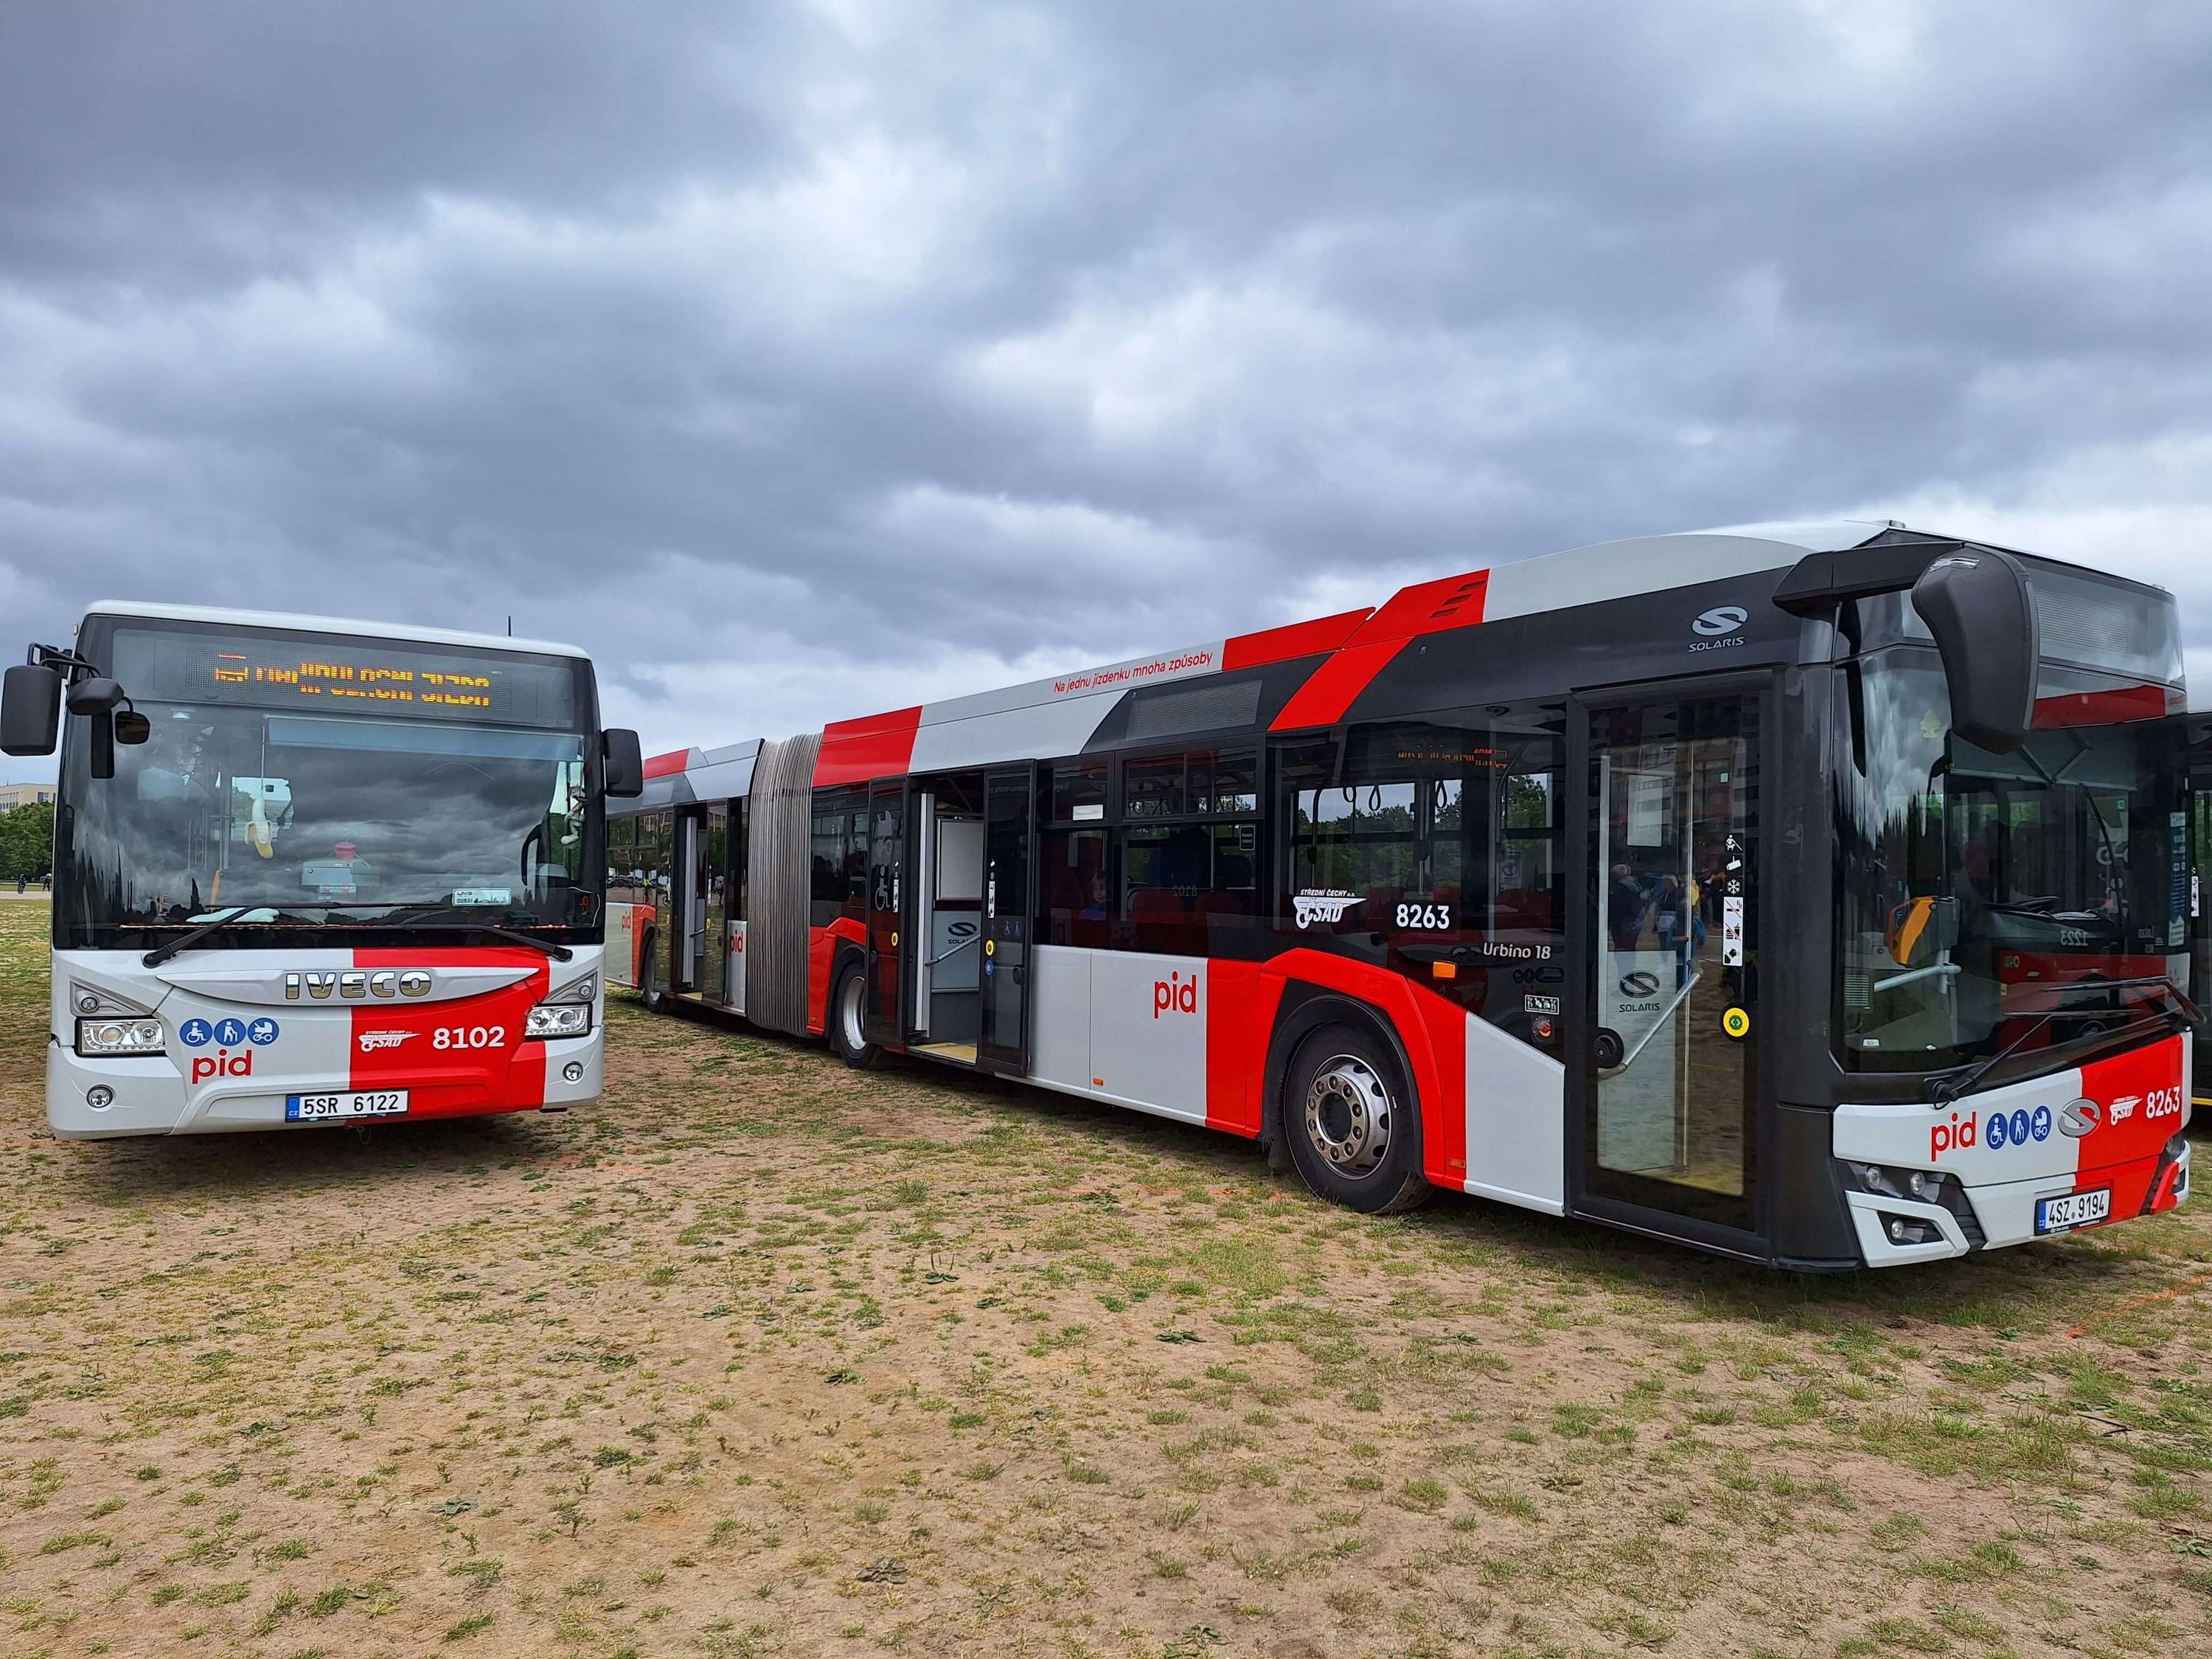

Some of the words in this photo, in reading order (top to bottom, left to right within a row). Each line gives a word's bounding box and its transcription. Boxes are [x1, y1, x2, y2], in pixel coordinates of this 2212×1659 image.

[1688, 636, 1745, 653] SOLARIS
[1054, 681, 1065, 693] Na
[1066, 678, 1090, 694] jednu
[1091, 669, 1130, 689] jízdenku
[1133, 661, 1166, 677] mnoha
[1169, 650, 1213, 674] způsoby
[1300, 888, 1326, 897] STŘEDNÍ
[1326, 888, 1347, 897] ČECHY
[621, 910, 632, 933] pid
[1396, 903, 1450, 930] 8263
[728, 929, 743, 954] pid
[1484, 942, 1531, 958] Urbino
[1535, 945, 1551, 959] 18
[285, 970, 432, 1000] IVECO
[1153, 970, 1197, 1019] pid
[1618, 1003, 1660, 1013] SOLARIS
[432, 1026, 506, 1050] 8102
[192, 1048, 252, 1085] pid
[304, 1097, 338, 1115] 5SR
[354, 1094, 399, 1112] 6122
[2146, 1085, 2180, 1119] 8263
[1930, 1110, 1977, 1162] pid
[2049, 1200, 2070, 1224] 4SZ
[2078, 1193, 2104, 1218] 9194
